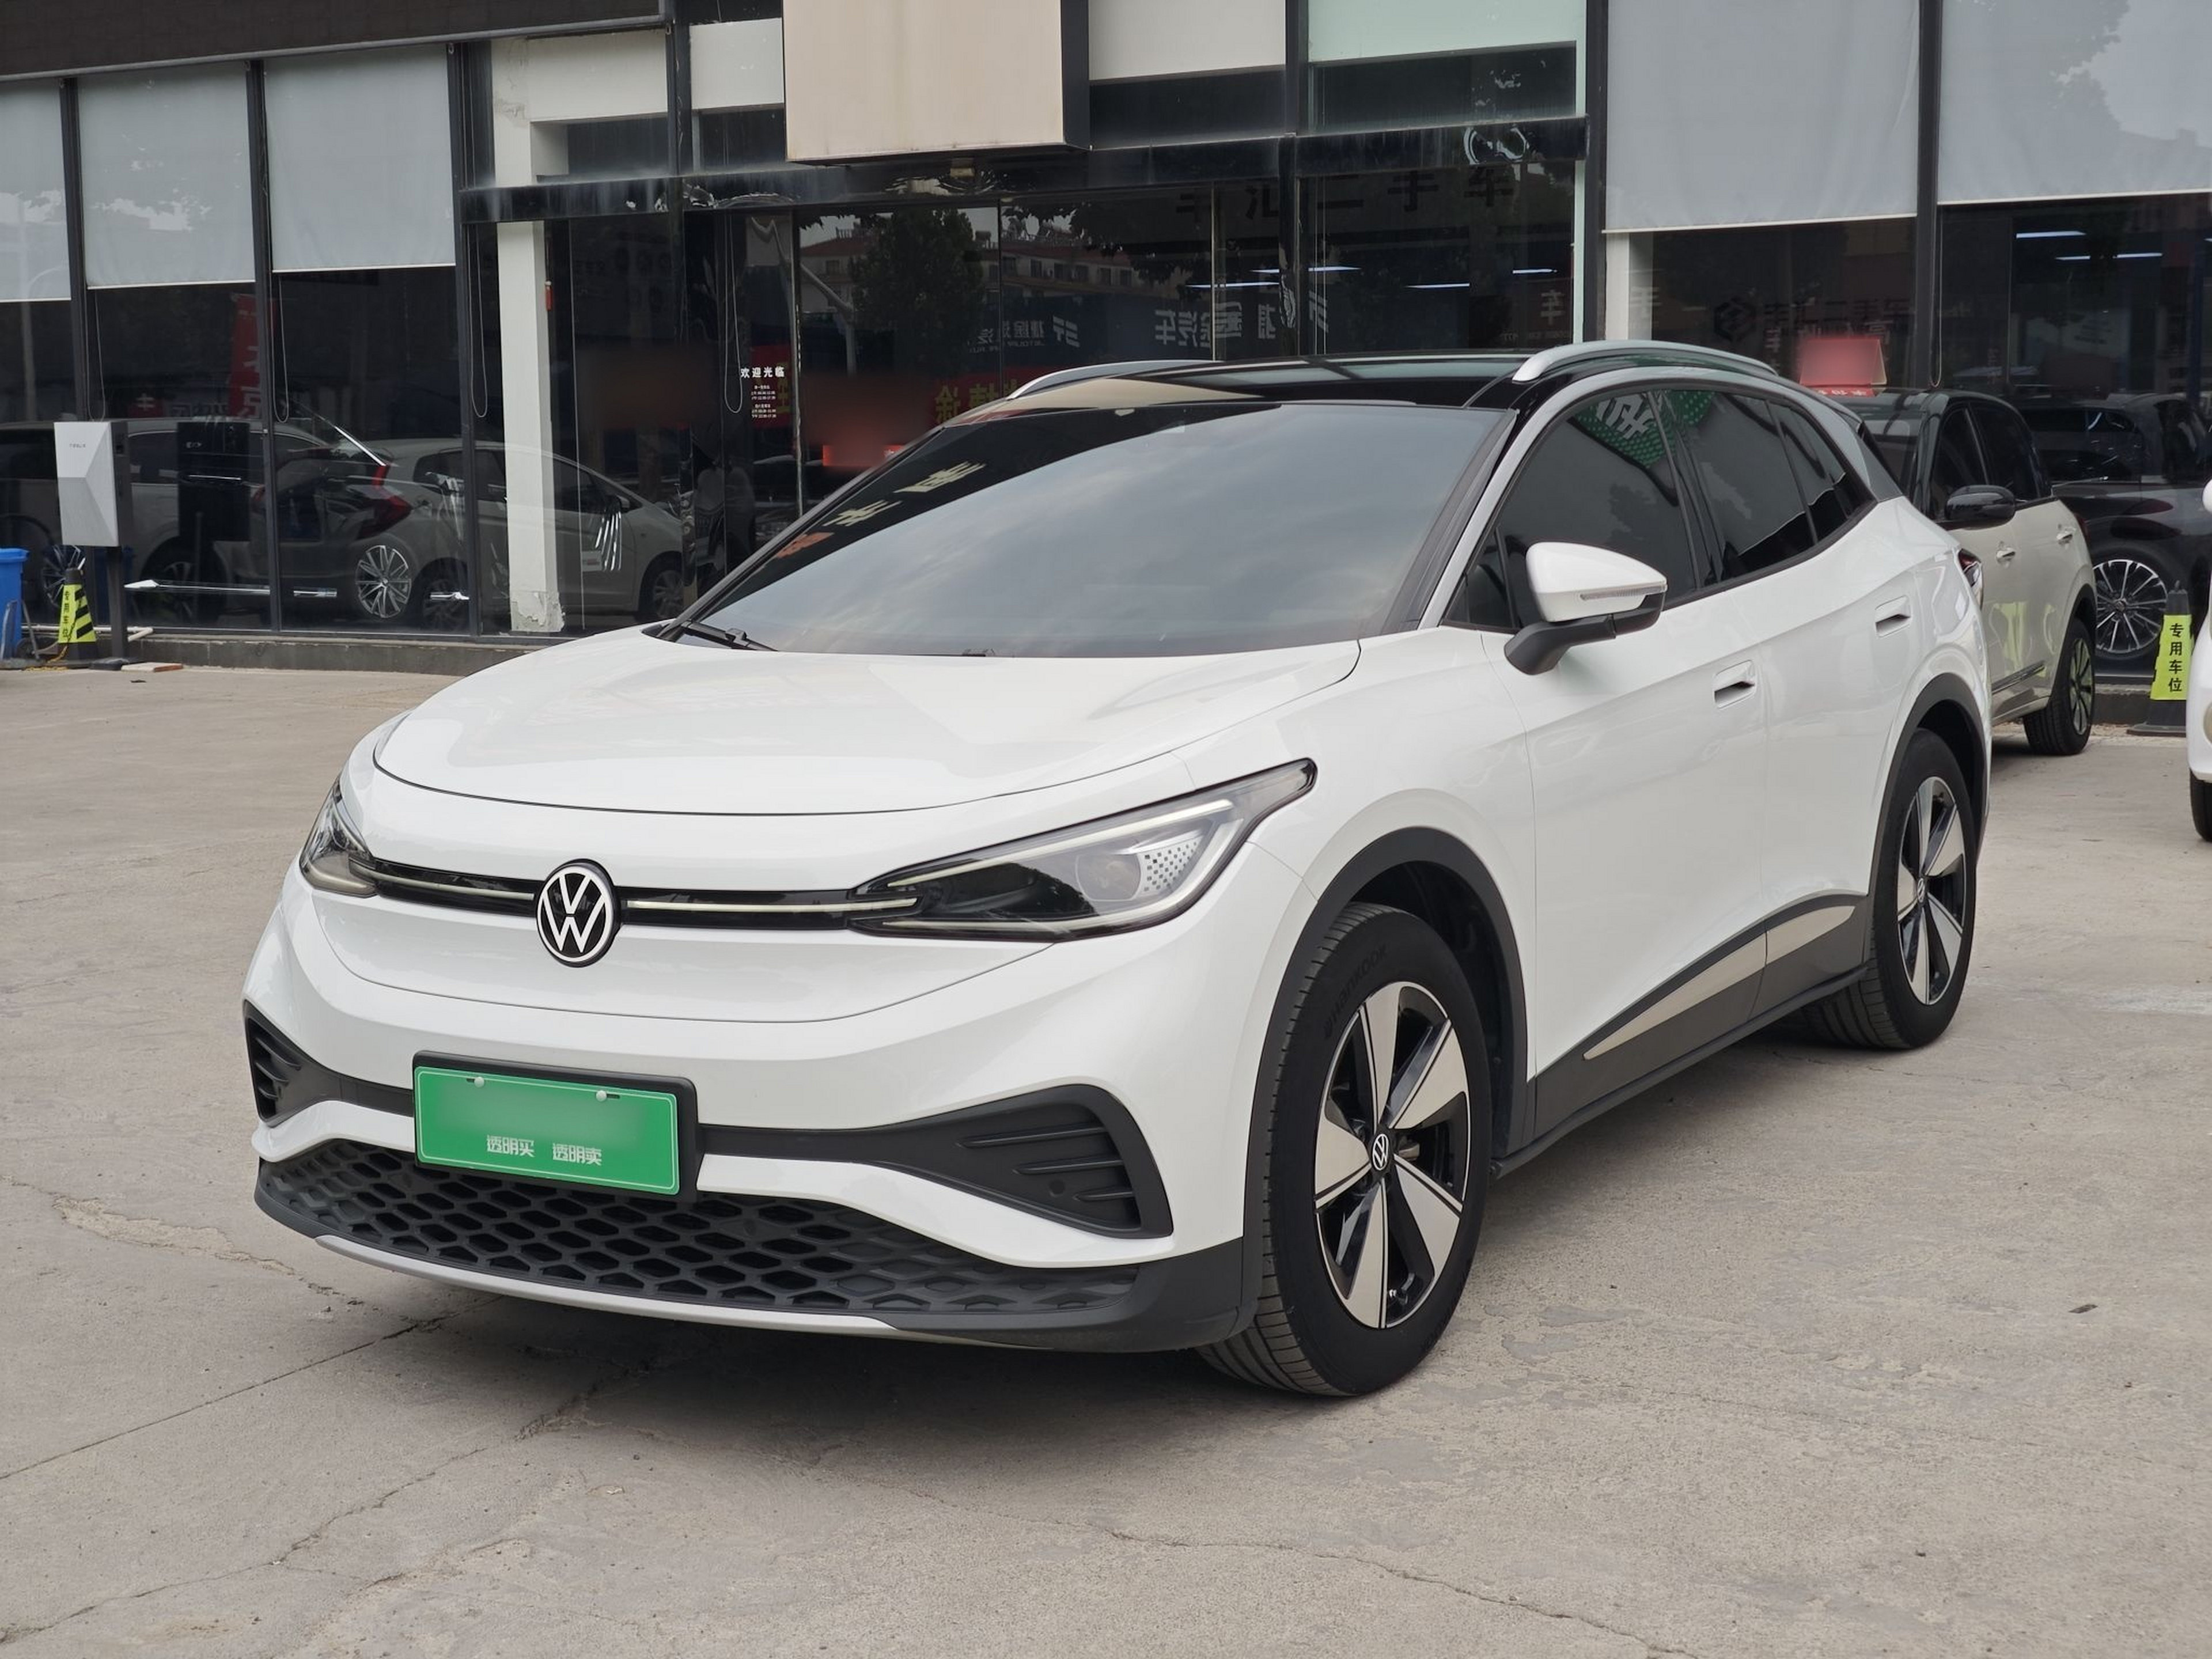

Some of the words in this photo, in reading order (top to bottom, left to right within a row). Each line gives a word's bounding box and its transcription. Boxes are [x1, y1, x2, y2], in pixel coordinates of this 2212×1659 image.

[740, 366, 785, 378] 欢迎光临
[2168, 623, 2184, 692] 专用车位
[486, 1134, 535, 1158] 透明买
[552, 1142, 603, 1167] 透明卖
